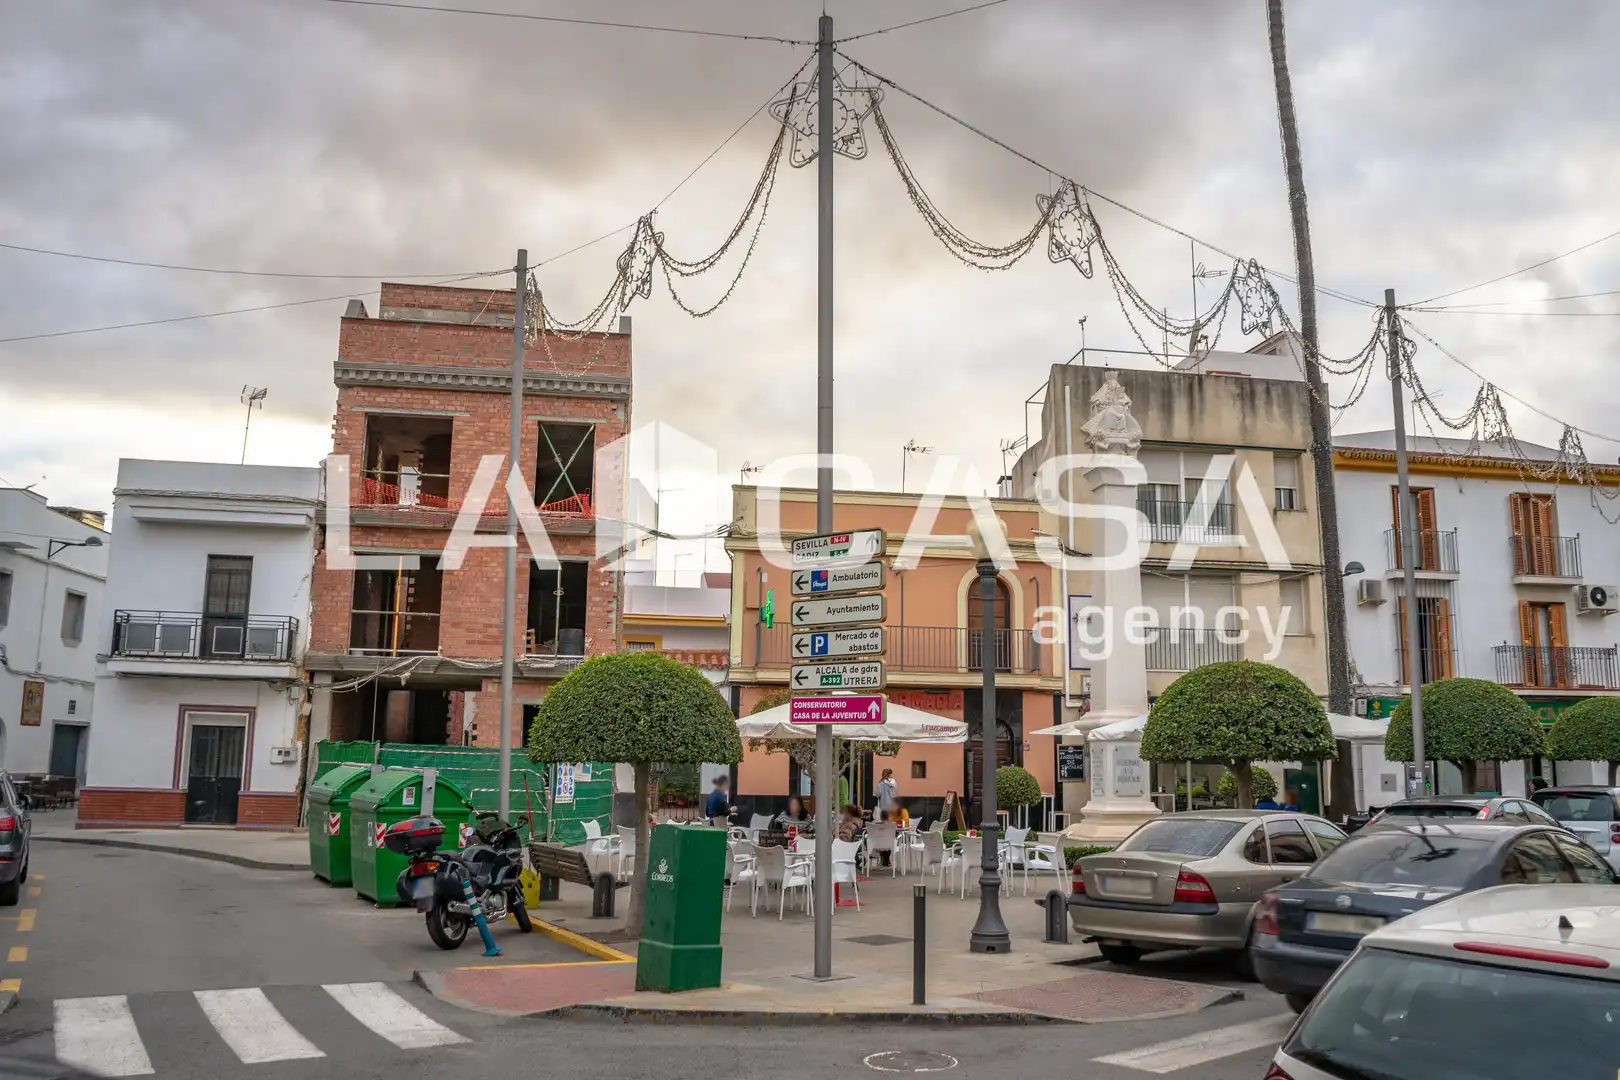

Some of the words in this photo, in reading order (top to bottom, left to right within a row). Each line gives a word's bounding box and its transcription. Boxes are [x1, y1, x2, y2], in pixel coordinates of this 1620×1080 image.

[795, 539, 829, 551] SEVILLA
[833, 536, 847, 544] N-IV
[831, 570, 879, 582] Ambulatorio
[826, 603, 880, 615] Ayuntamiento
[815, 636, 825, 653] P
[835, 632, 868, 641] Mercado
[869, 630, 879, 639] de
[848, 643, 879, 652] abastos
[815, 667, 848, 675] ALCALA
[861, 665, 878, 675] gdra
[843, 677, 878, 686] UTRERA
[793, 701, 847, 709] CONSERVATORIO
[921, 723, 959, 733] Cruzcampo
